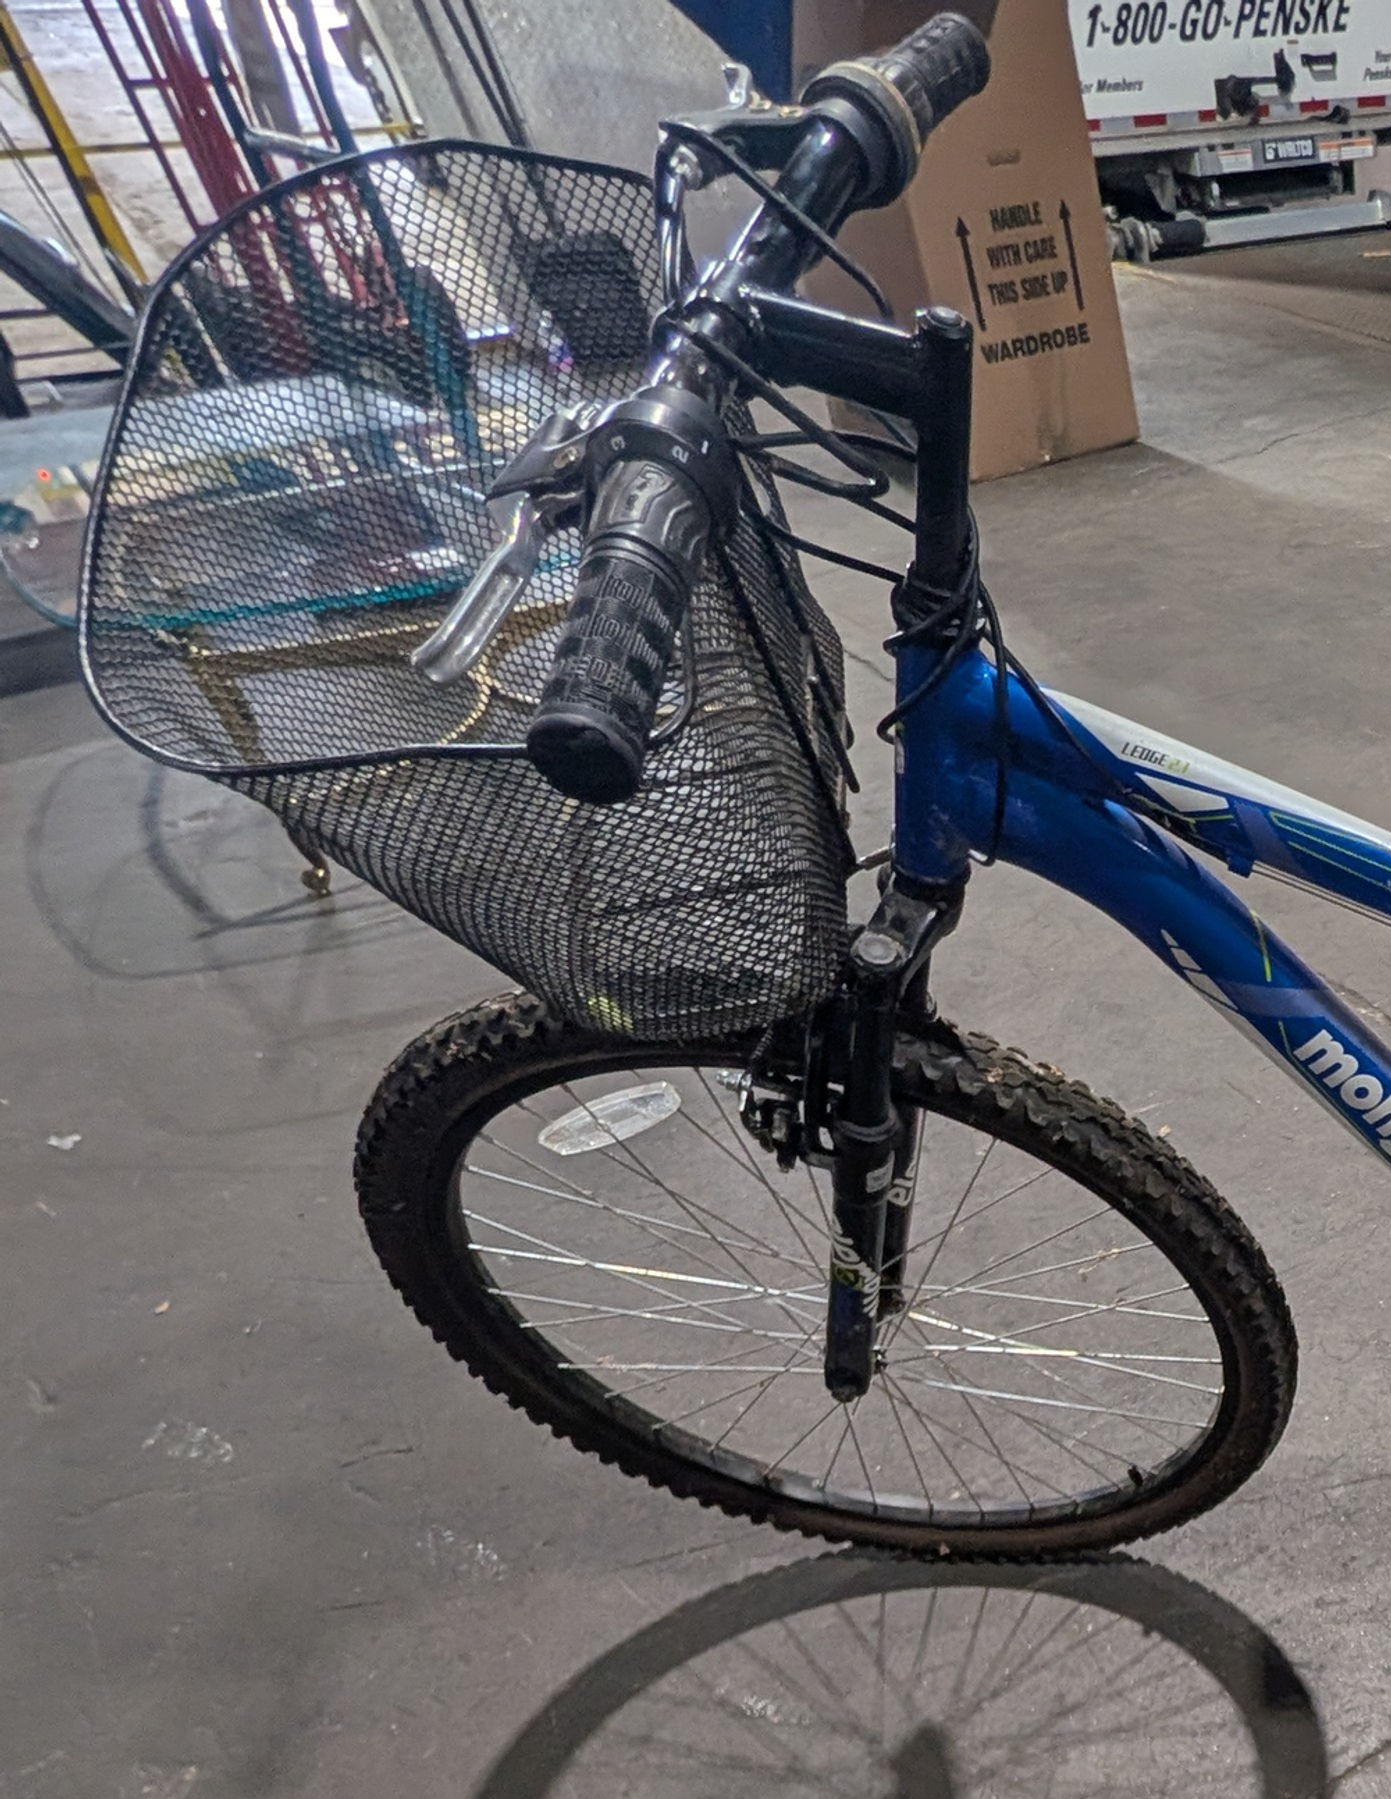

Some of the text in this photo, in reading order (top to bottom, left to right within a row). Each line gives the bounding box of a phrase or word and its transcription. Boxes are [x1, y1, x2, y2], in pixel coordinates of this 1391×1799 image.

[1086, 0, 1350, 47] 1-800-GO-PENSKE
[1095, 77, 1144, 93] Members
[989, 201, 1043, 233] HANDLE
[986, 236, 1058, 269] WITH CARE
[987, 270, 1069, 306] THIS SIDE UP
[980, 322, 1091, 364] WARDROBE
[1120, 741, 1169, 767] LEDGE
